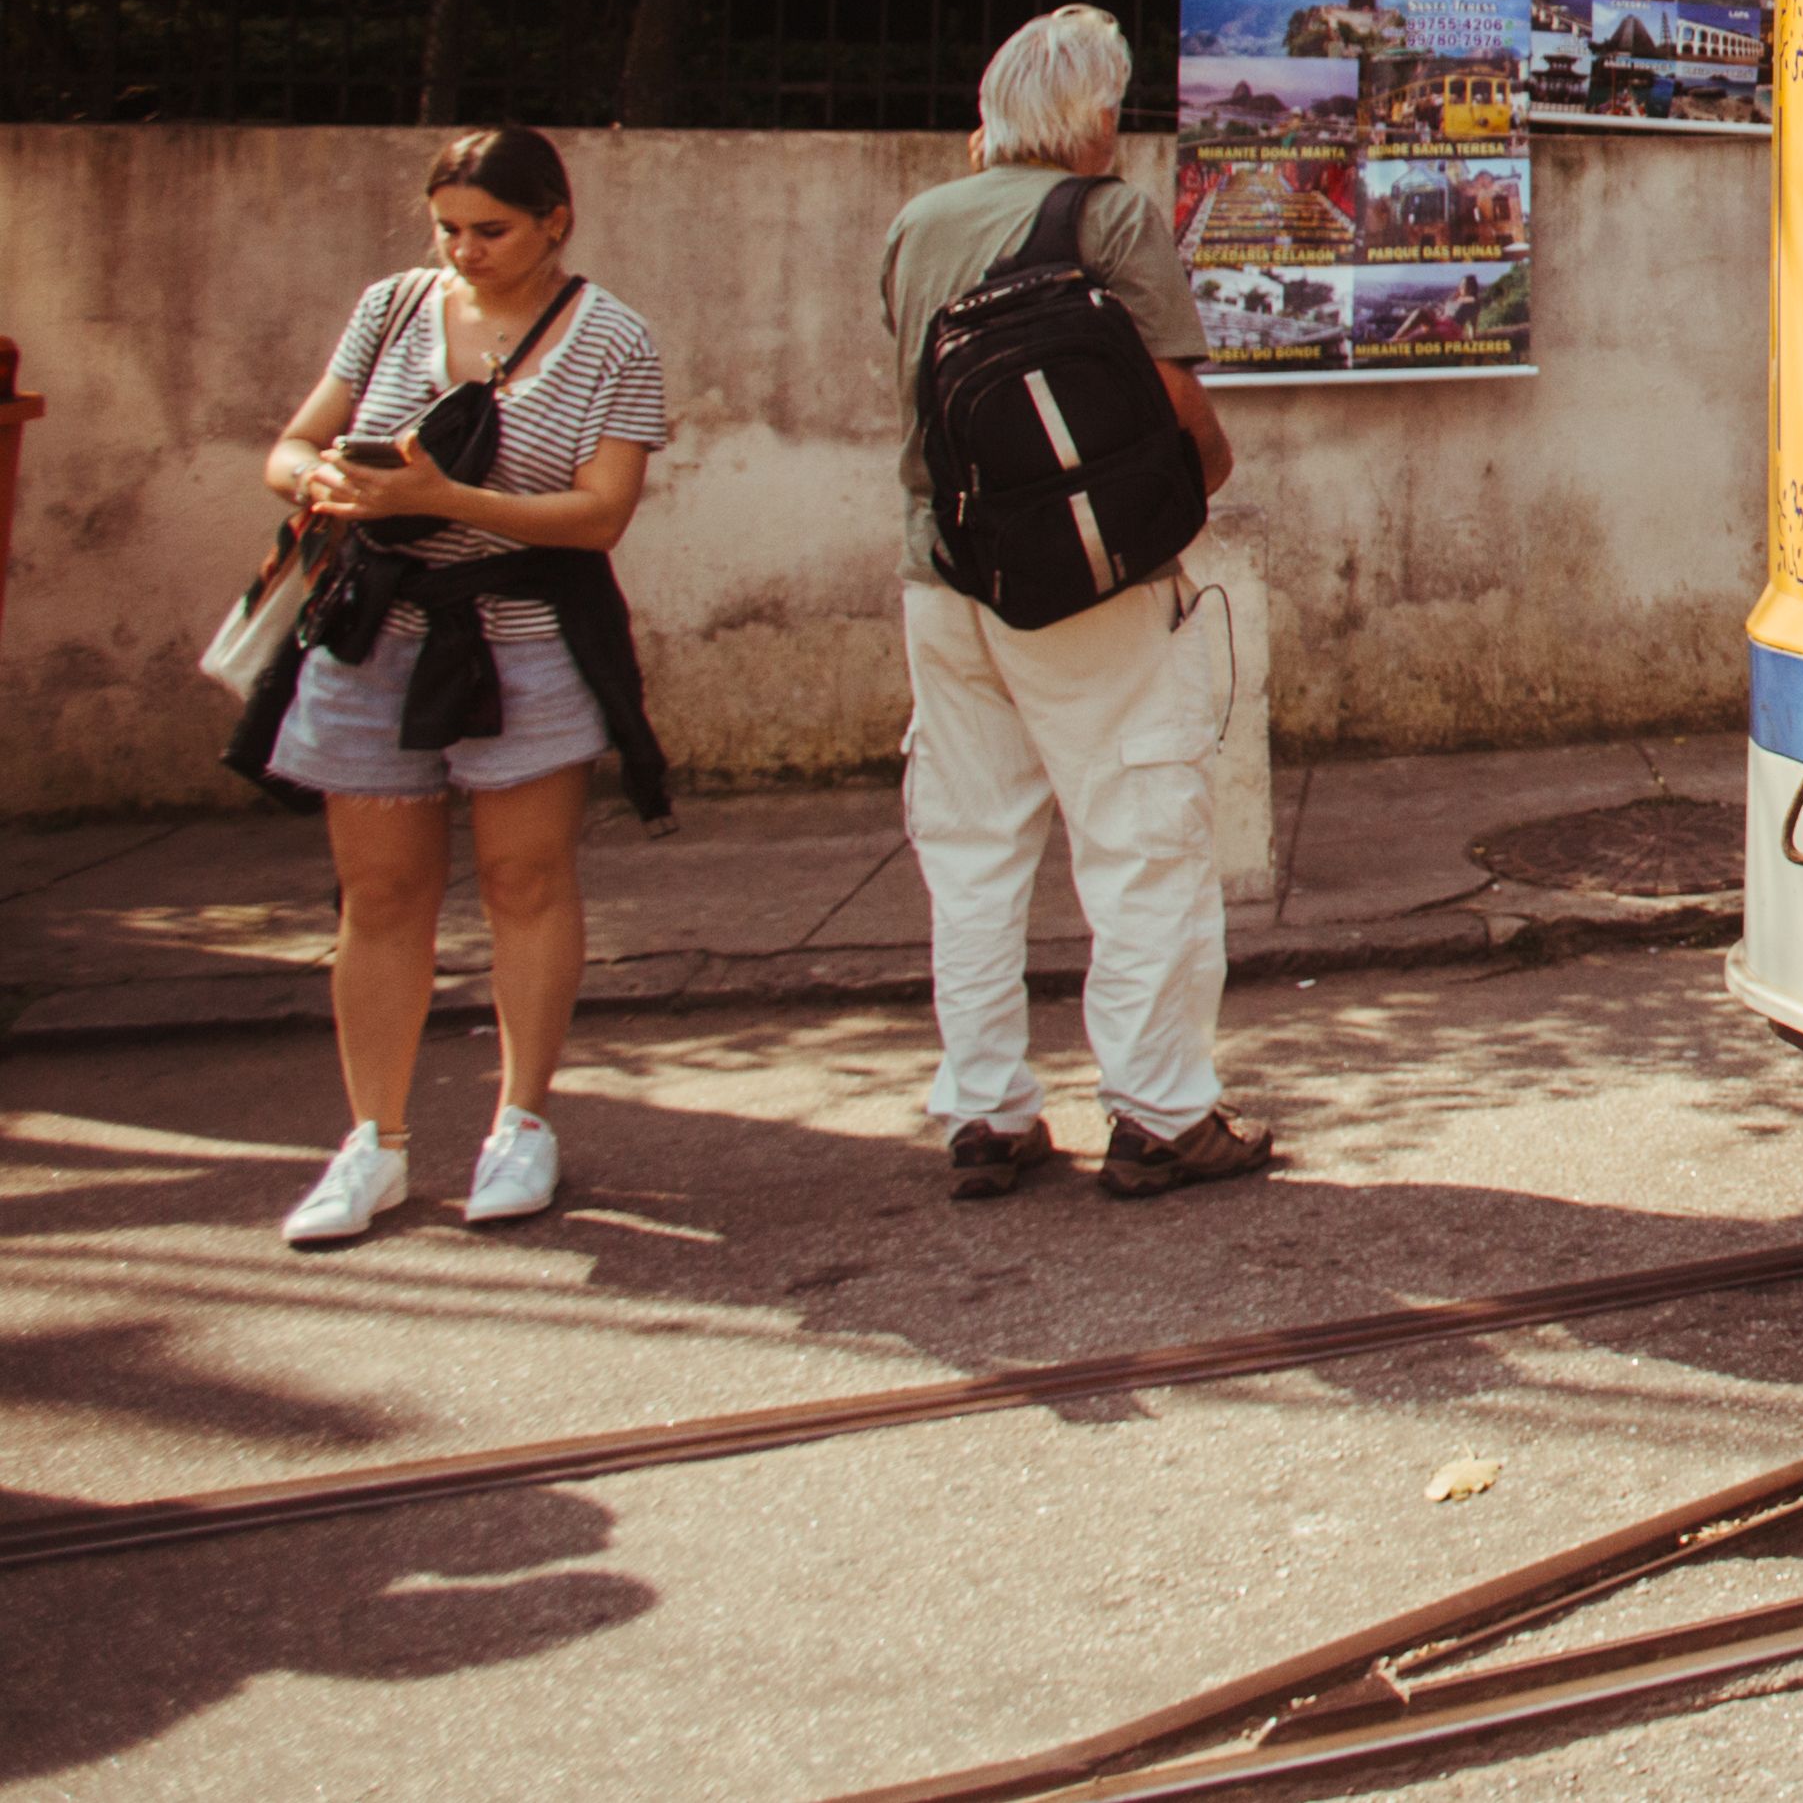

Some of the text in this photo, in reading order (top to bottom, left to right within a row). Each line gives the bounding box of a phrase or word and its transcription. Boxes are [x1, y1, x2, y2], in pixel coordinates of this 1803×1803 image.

[1198, 147, 1258, 160] MIRANTE
[1301, 147, 1346, 159] MARTA
[1412, 143, 1452, 156] SANTA
[1454, 142, 1504, 156] TERESA
[1367, 247, 1420, 261] PARQUE
[1424, 246, 1449, 259] DAS
[1252, 347, 1272, 359] DO
[1275, 345, 1322, 359] BONDE
[1355, 340, 1511, 357] MIRANTE DOS PRAZERES
